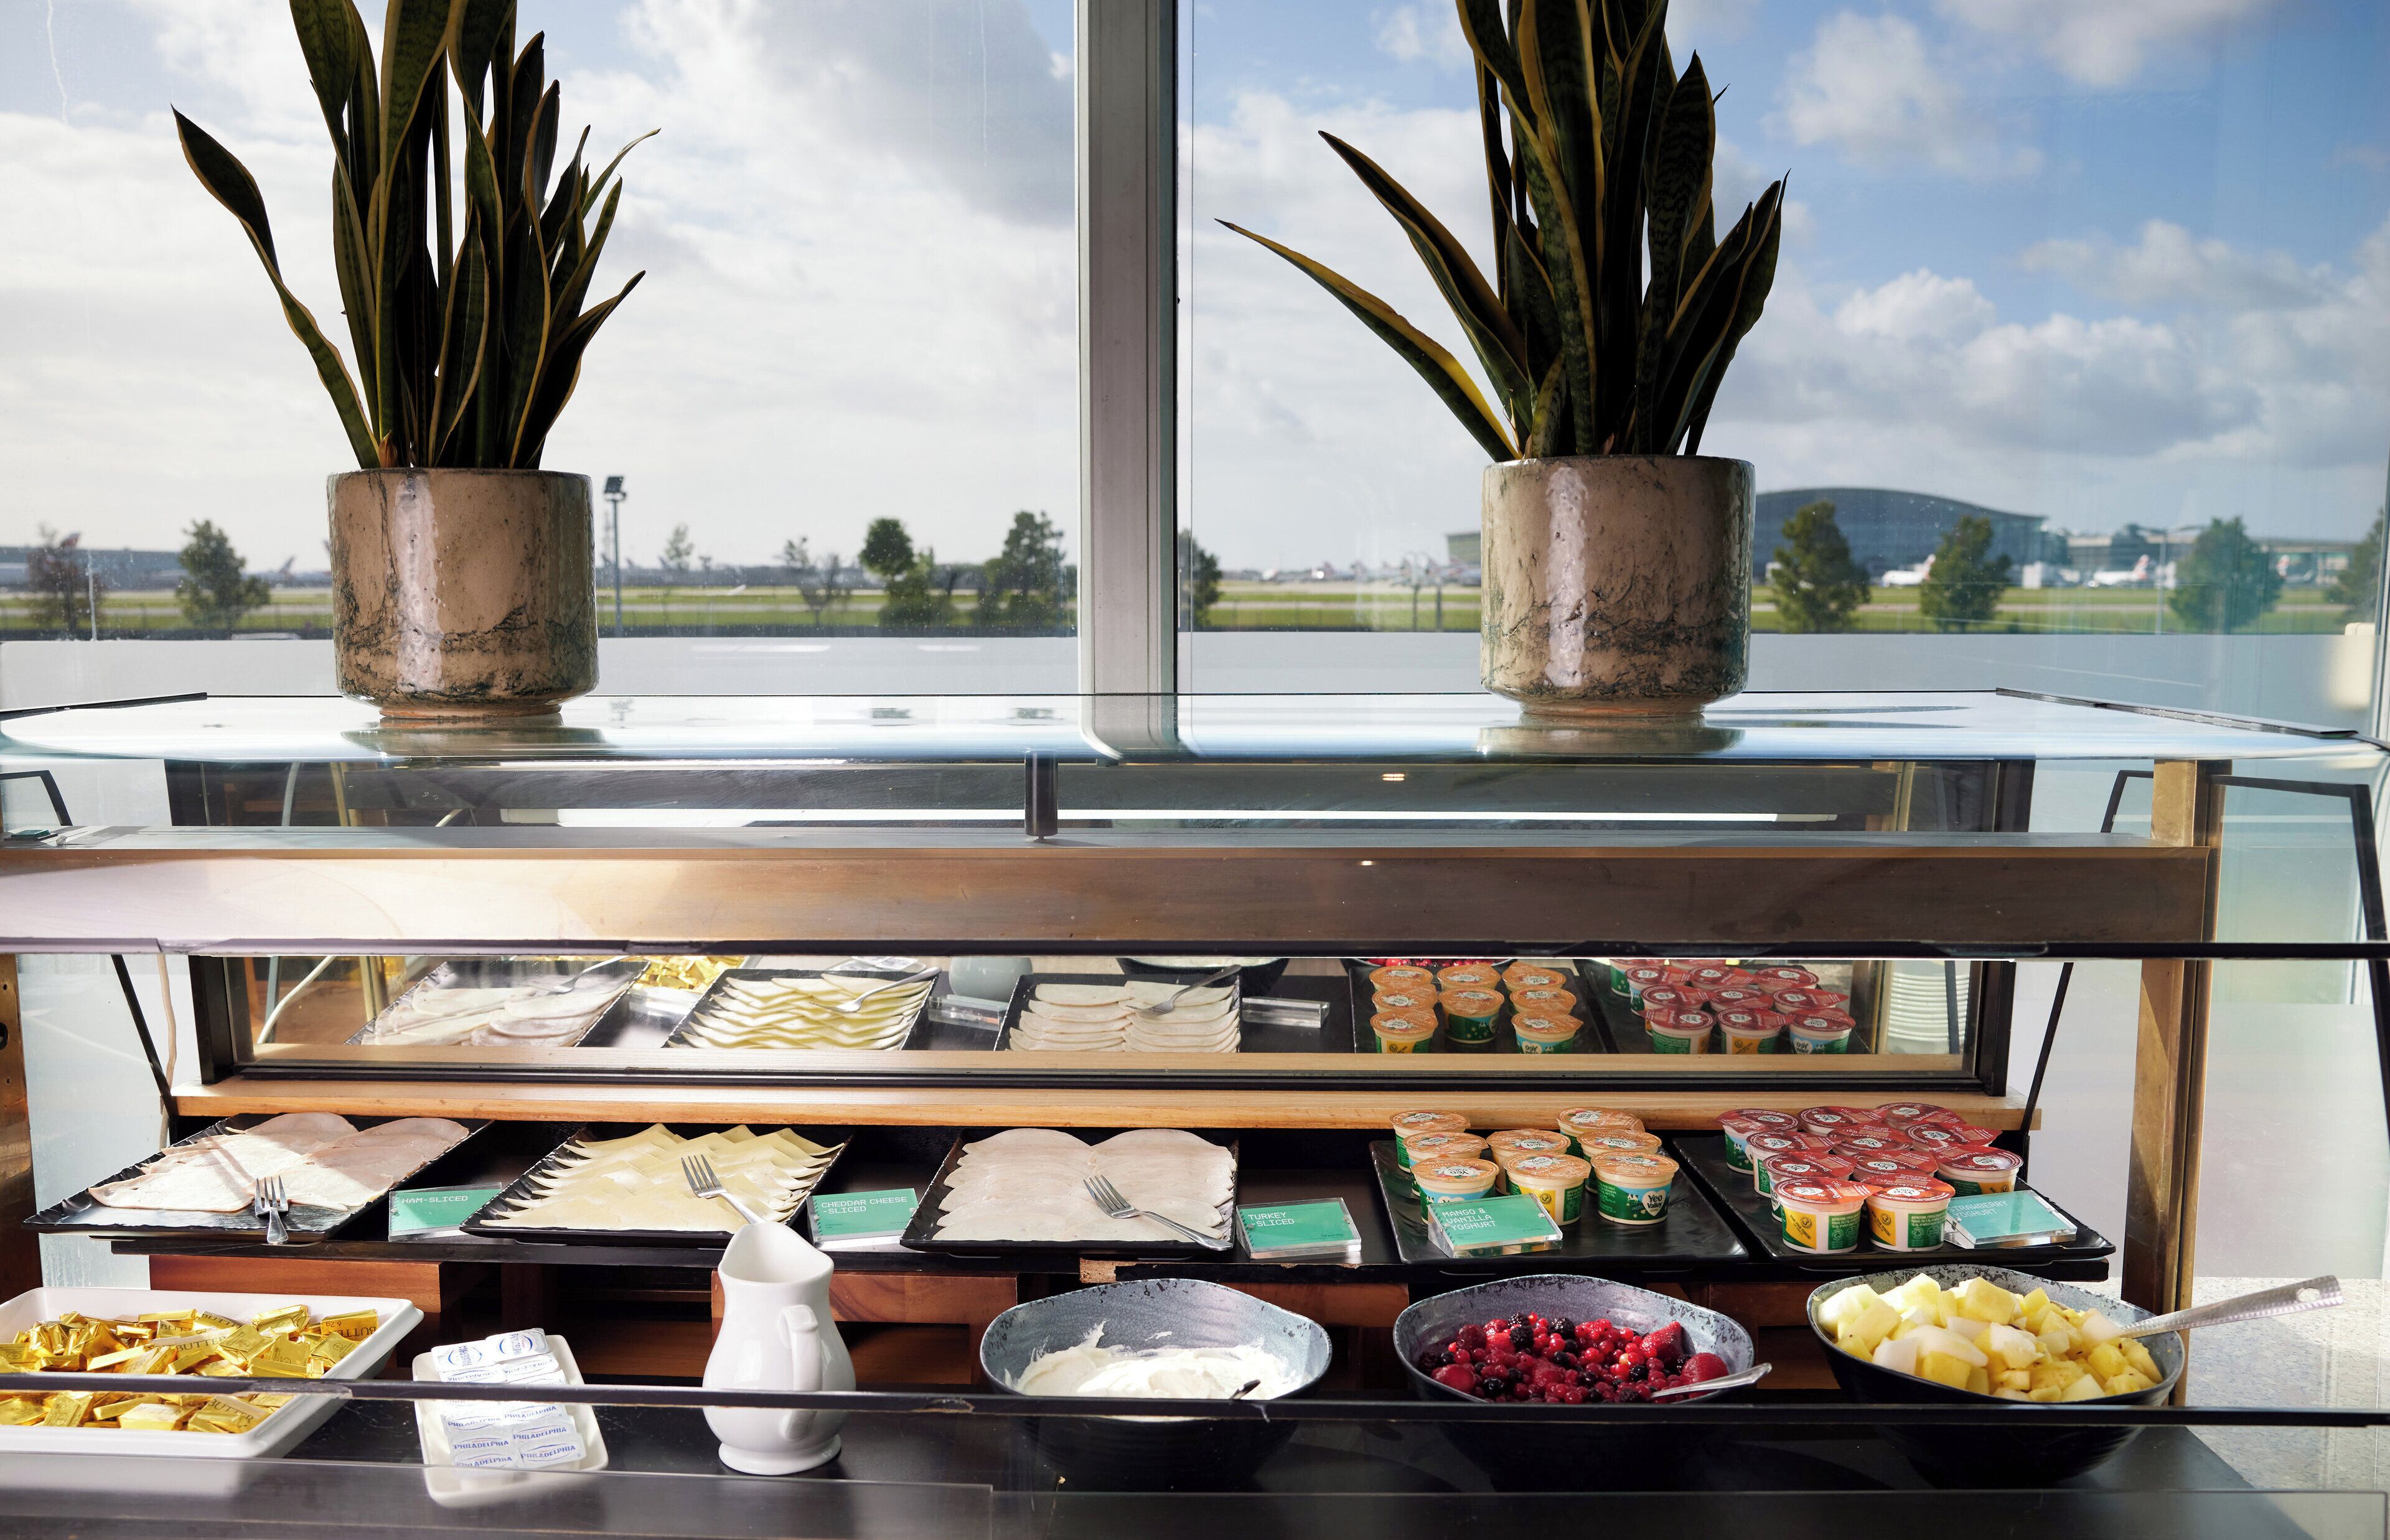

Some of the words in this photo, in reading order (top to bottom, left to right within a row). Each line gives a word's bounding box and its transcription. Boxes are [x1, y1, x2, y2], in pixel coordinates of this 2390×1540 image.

[401, 1195, 468, 1203] HAM-SLICED
[821, 1200, 866, 1208] CHEDDAR
[869, 1197, 908, 1205] CHEESE
[823, 1206, 866, 1214] -SLICED
[1947, 1200, 2009, 1213] STRAWBERRY
[1248, 1212, 1286, 1221] TURKEY
[1441, 1209, 1476, 1217] MANGO
[1953, 1208, 1998, 1220] YOGHURT
[1251, 1218, 1295, 1227] -SLICED
[1446, 1215, 1493, 1224] VANILLA
[1450, 1221, 1496, 1231] YOGHURT
[504, 1405, 557, 1419] PHILADELPHIA
[512, 1427, 568, 1440] PHILADELPHIA
[453, 1440, 509, 1450] PHILADELPHIA
[520, 1445, 576, 1460] PHILADELPHIA
